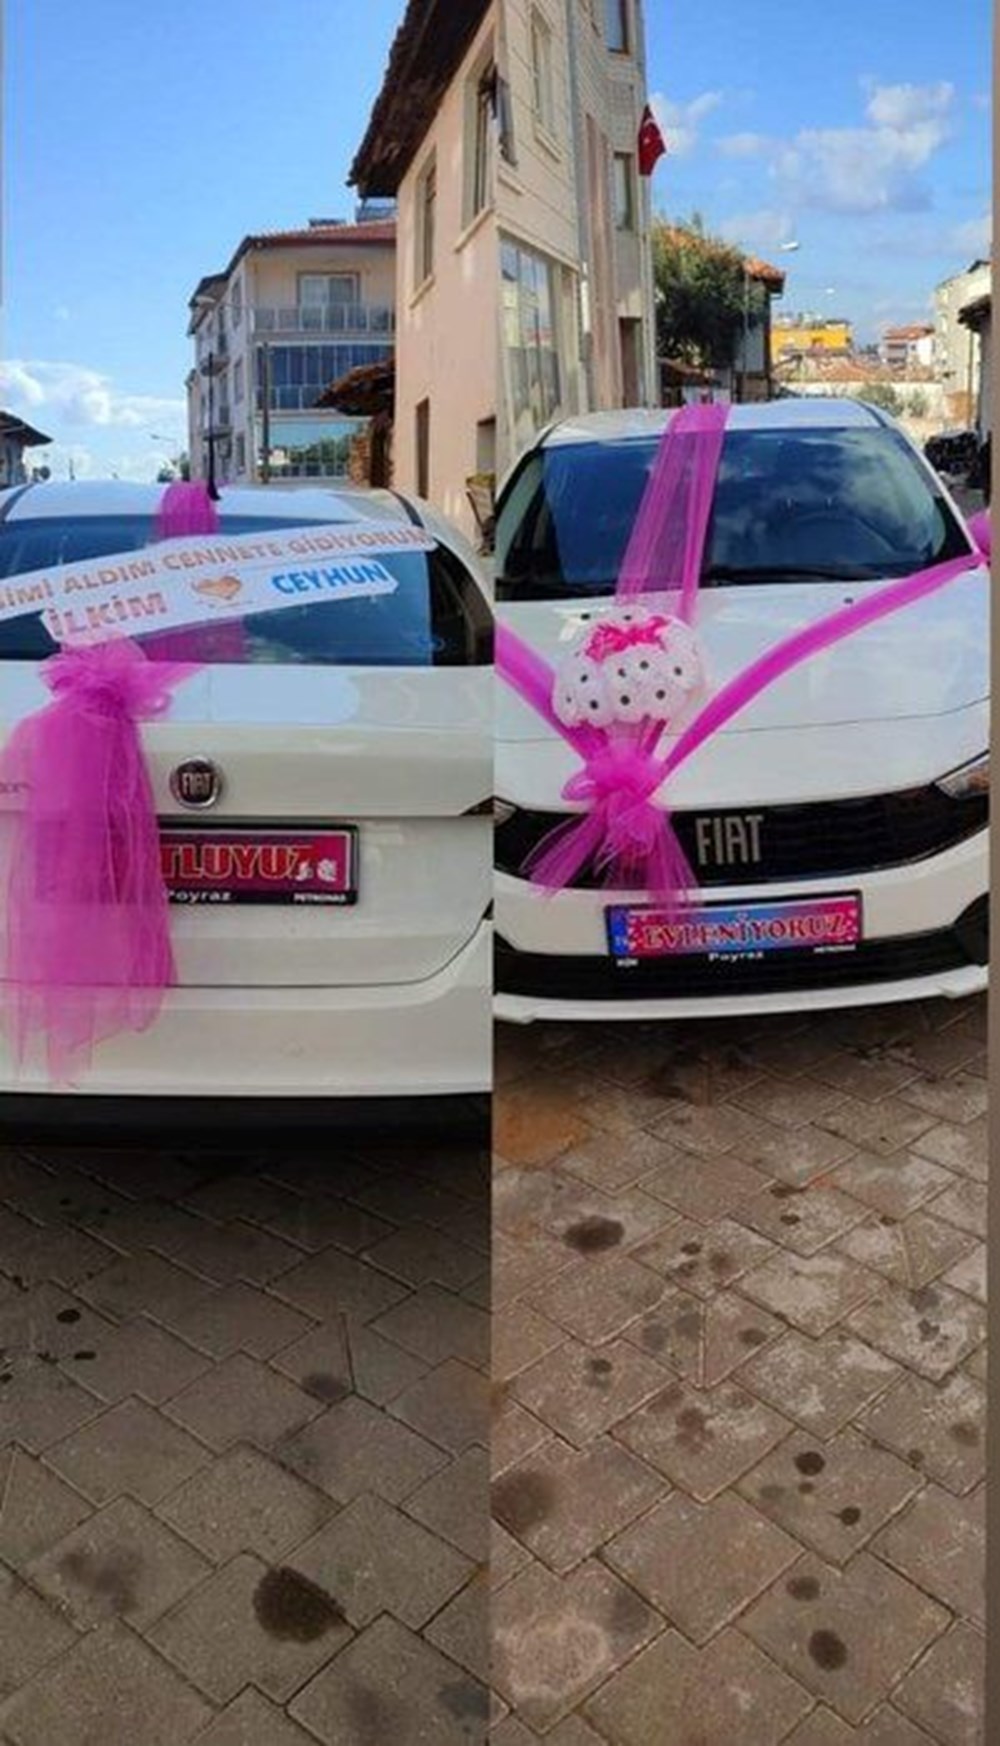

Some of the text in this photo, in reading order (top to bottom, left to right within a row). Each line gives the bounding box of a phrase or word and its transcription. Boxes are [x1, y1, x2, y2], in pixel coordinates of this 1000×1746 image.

[63, 560, 158, 594] ALDIM
[162, 541, 281, 571] CENNETE
[287, 527, 428, 554] GİDİYORUM
[49, 563, 386, 638] İLKİM CEYHUN
[180, 771, 214, 796] FIAT
[160, 844, 316, 880] TLUYUZ
[695, 815, 763, 866] FIAT
[642, 913, 847, 950] EVLENİYORUZ
